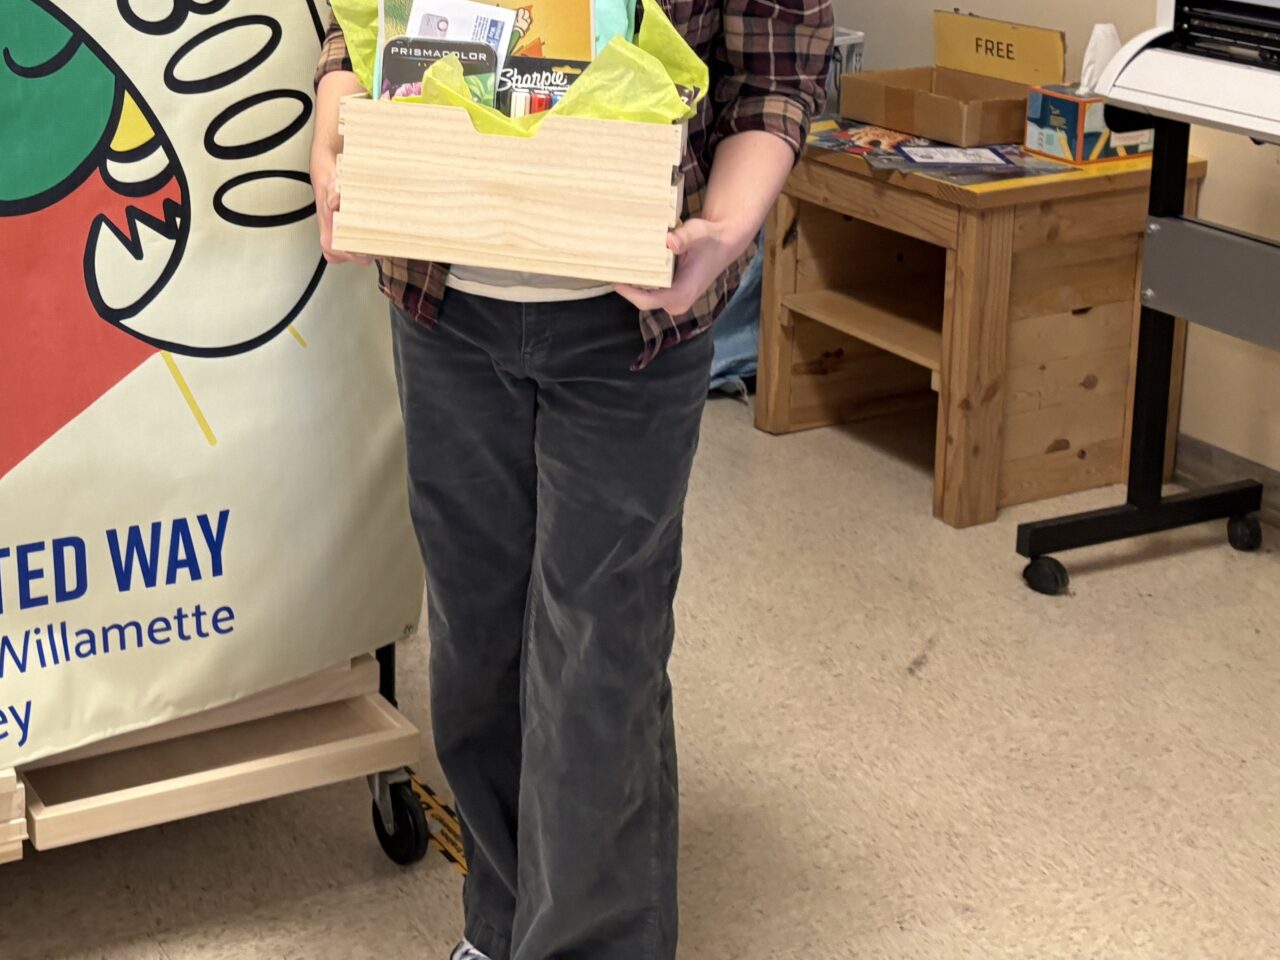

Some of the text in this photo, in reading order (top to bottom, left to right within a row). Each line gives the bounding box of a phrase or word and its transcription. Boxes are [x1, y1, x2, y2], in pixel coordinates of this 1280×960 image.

[975, 37, 1016, 60] FREE
[496, 67, 568, 91] Sharpie
[105, 509, 231, 593] WAY
